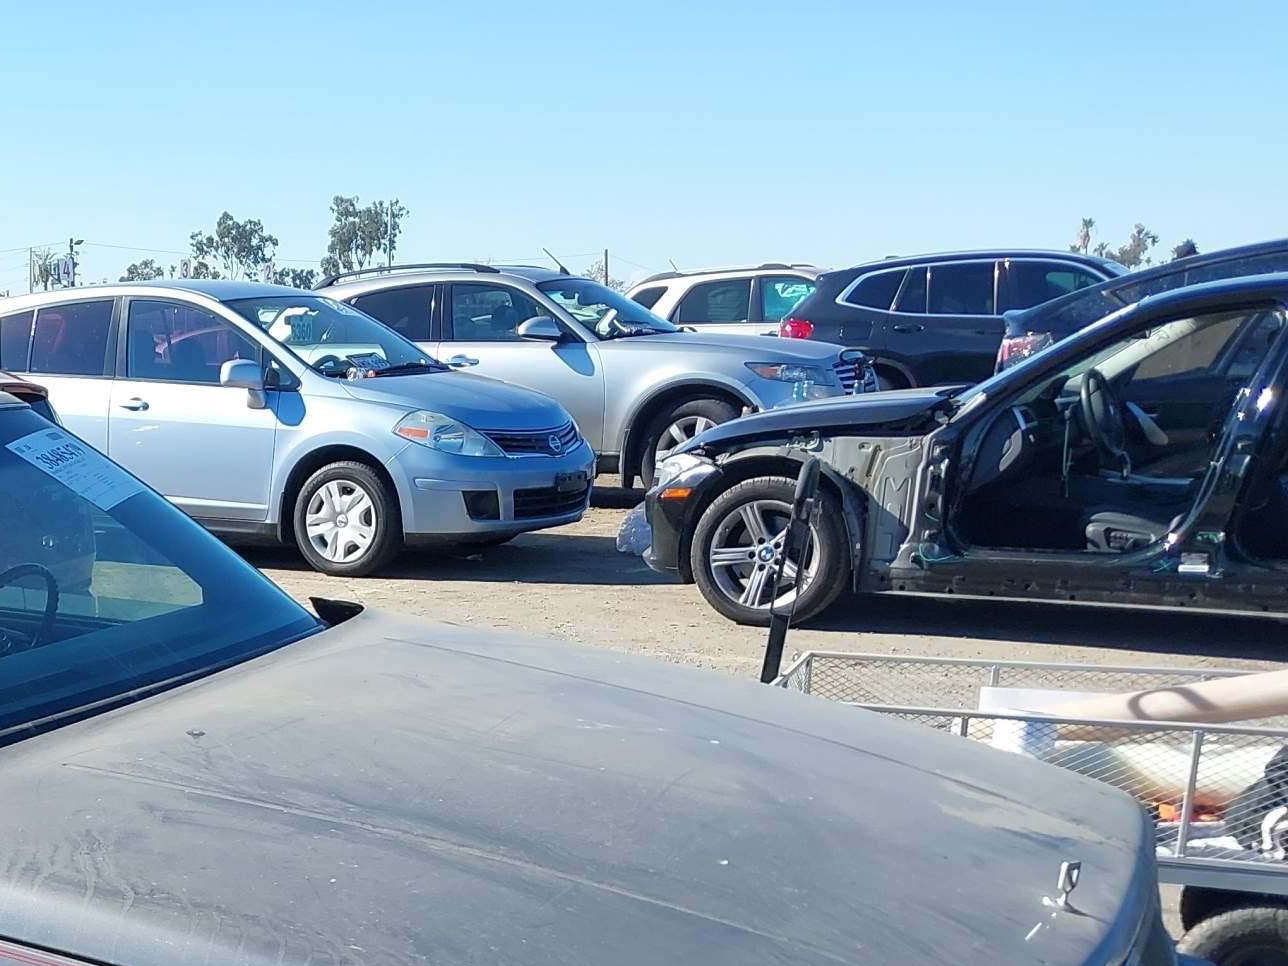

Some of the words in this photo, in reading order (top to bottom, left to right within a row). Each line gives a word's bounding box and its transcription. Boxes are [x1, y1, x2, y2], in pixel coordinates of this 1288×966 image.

[63, 260, 71, 278] 4
[182, 262, 189, 278] 3
[265, 265, 272, 280] 2
